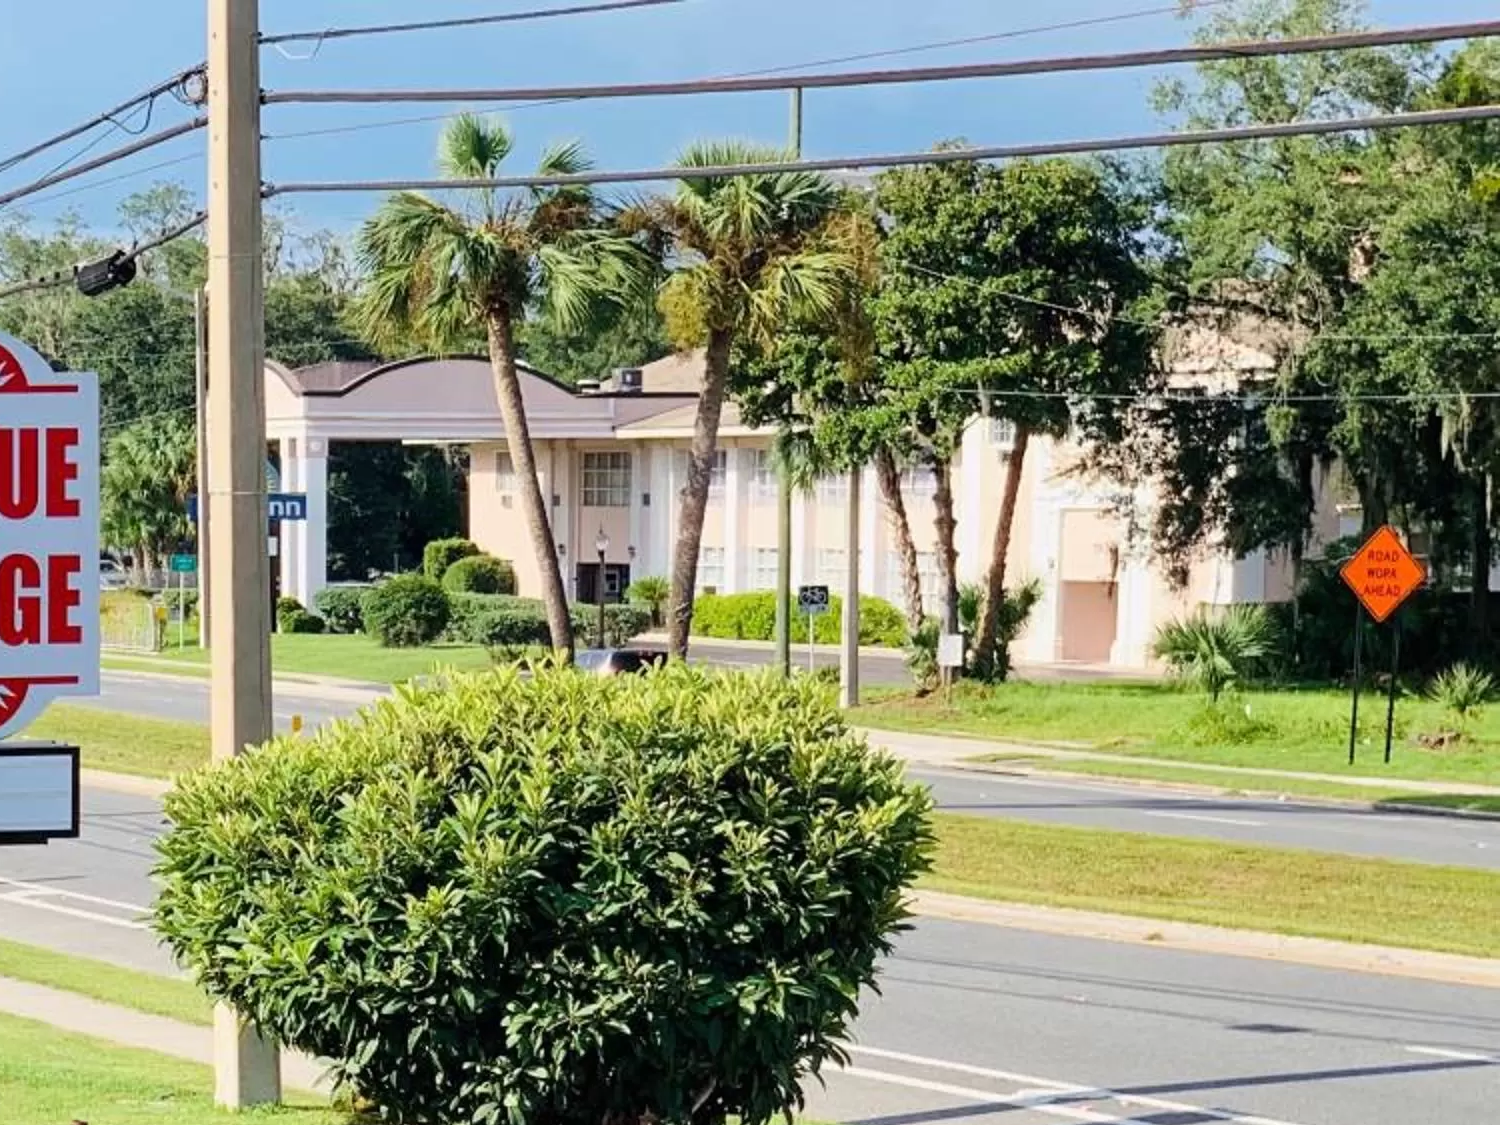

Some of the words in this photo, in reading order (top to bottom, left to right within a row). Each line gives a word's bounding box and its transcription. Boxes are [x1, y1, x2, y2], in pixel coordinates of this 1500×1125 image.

[1367, 549, 1400, 562] ROAD
[1367, 567, 1397, 579] WORK
[1363, 584, 1401, 597] AHEAD
